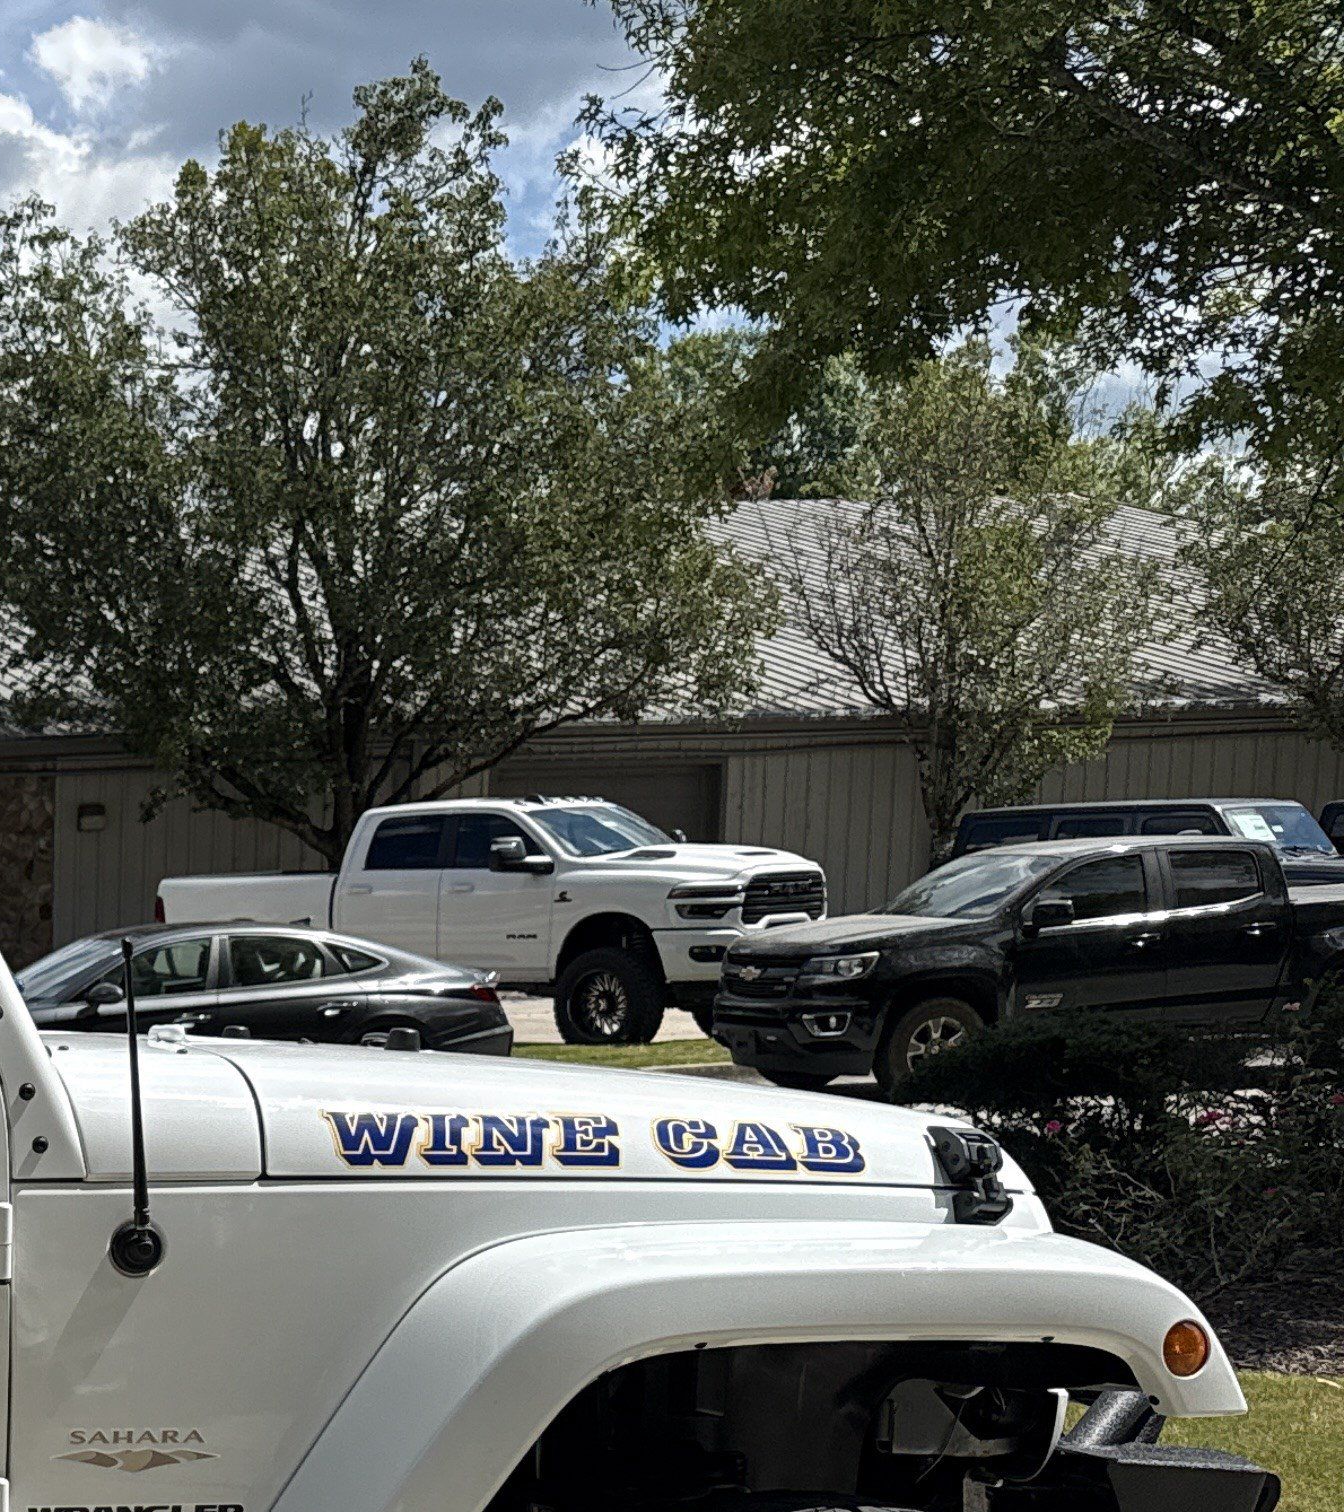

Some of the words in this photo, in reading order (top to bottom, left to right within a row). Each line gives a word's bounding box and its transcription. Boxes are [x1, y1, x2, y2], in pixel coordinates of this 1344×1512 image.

[319, 1109, 621, 1169] WINE
[649, 1115, 869, 1175] CAB
[69, 1428, 206, 1445] SAHARA
